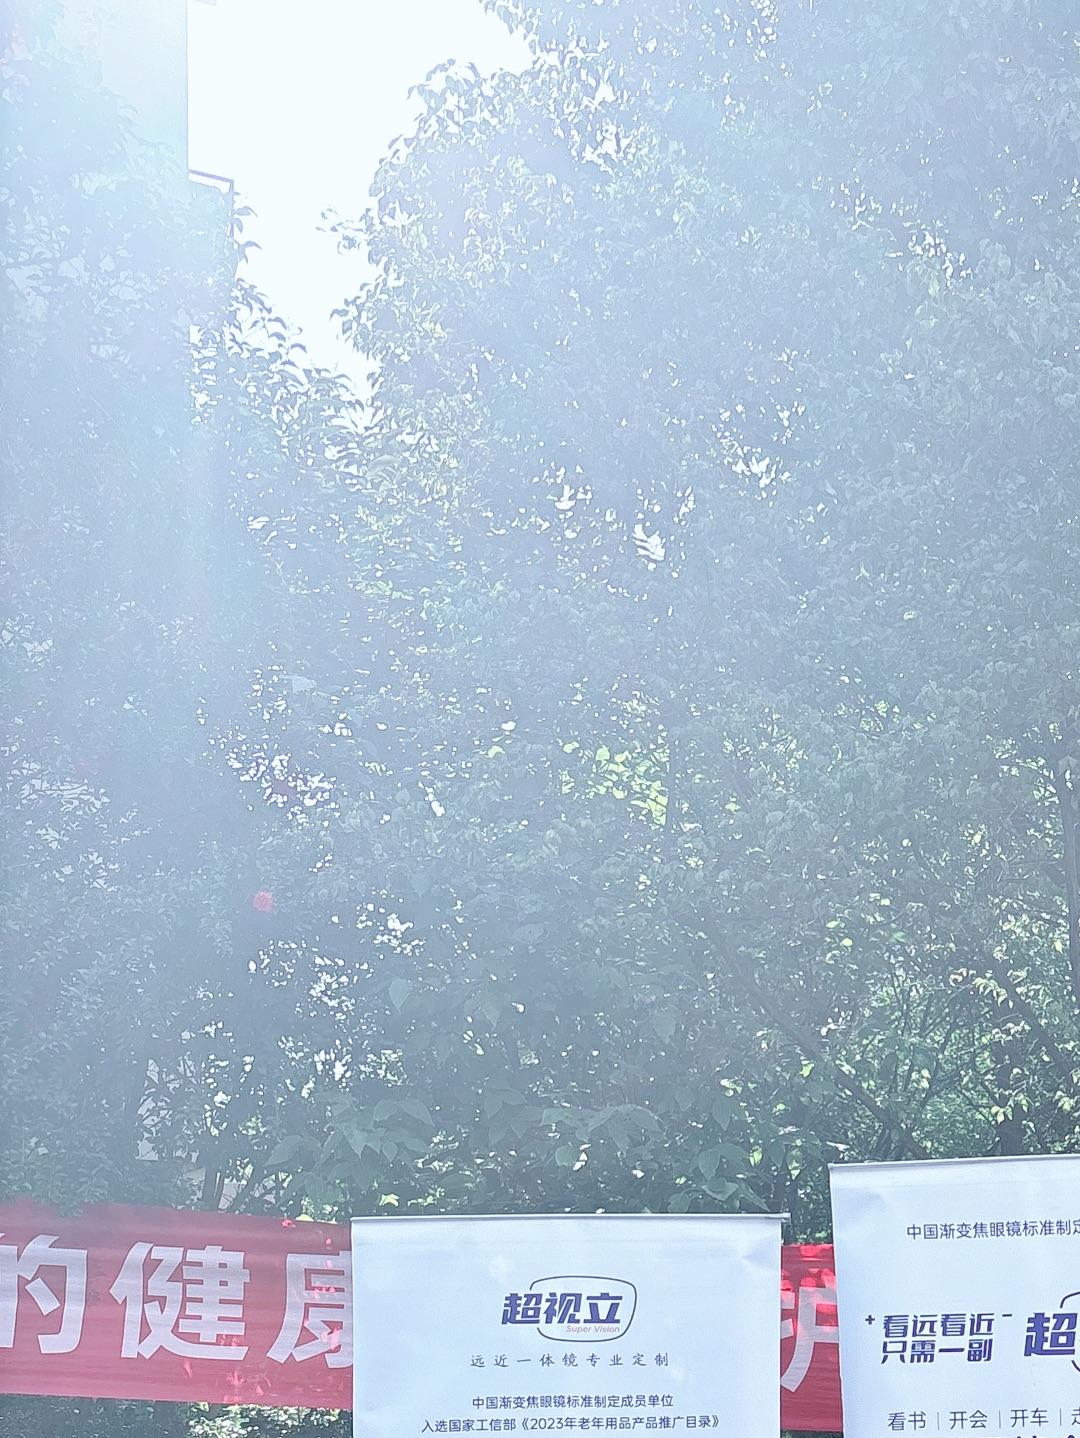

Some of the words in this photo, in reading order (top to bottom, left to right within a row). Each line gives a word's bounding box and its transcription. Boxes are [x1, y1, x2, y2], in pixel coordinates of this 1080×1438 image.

[501, 1291, 624, 1325] 超视立
[564, 1322, 591, 1337] Super
[593, 1320, 621, 1334] Vision
[882, 1312, 996, 1338] 看远看近
[470, 1352, 669, 1368] 远近一体镜专业定制
[880, 1338, 994, 1366] 只需一副
[472, 1393, 675, 1412] 中国渐变焦眼镜标准制定成员单位
[421, 1413, 721, 1434] 入选国家工信部《2023年老年用品产品推广目录》
[887, 1410, 927, 1431] 看书
[948, 1409, 988, 1430] 开会
[1010, 1407, 1049, 1428] 开车
